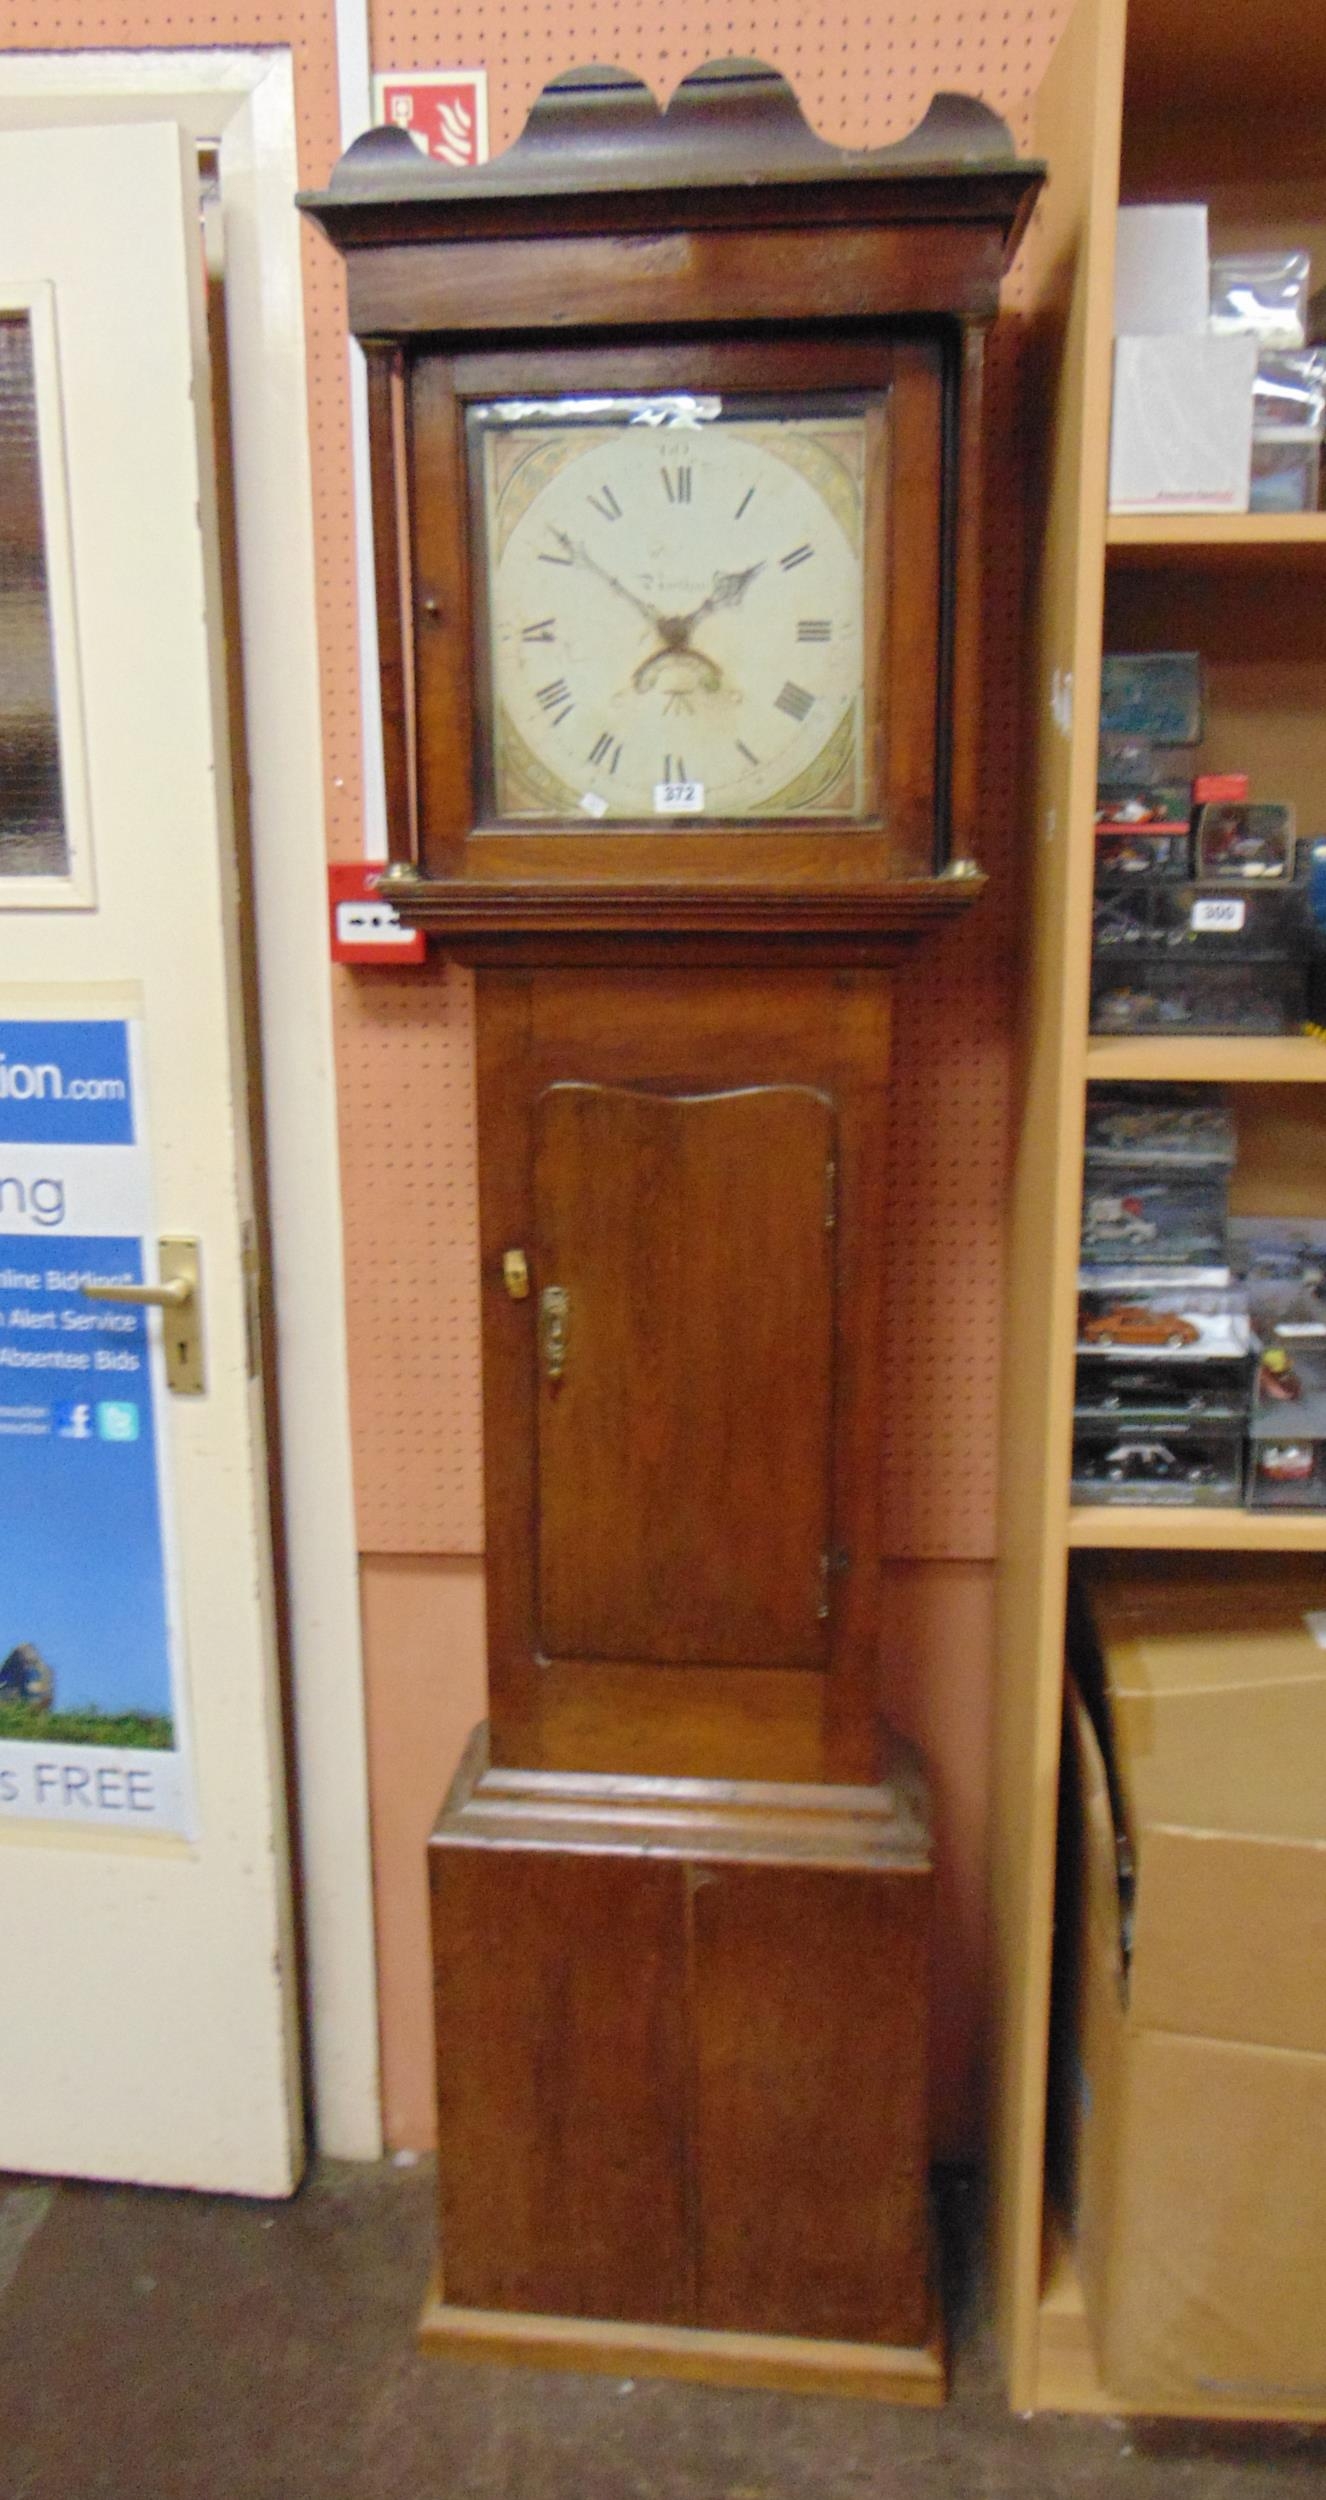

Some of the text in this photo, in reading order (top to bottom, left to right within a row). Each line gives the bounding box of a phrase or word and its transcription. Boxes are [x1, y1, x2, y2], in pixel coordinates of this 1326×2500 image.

[663, 785, 697, 802] 372
[61, 1310, 138, 1332] Service
[94, 1350, 141, 1371] Bids
[35, 1762, 156, 1811] FREE
